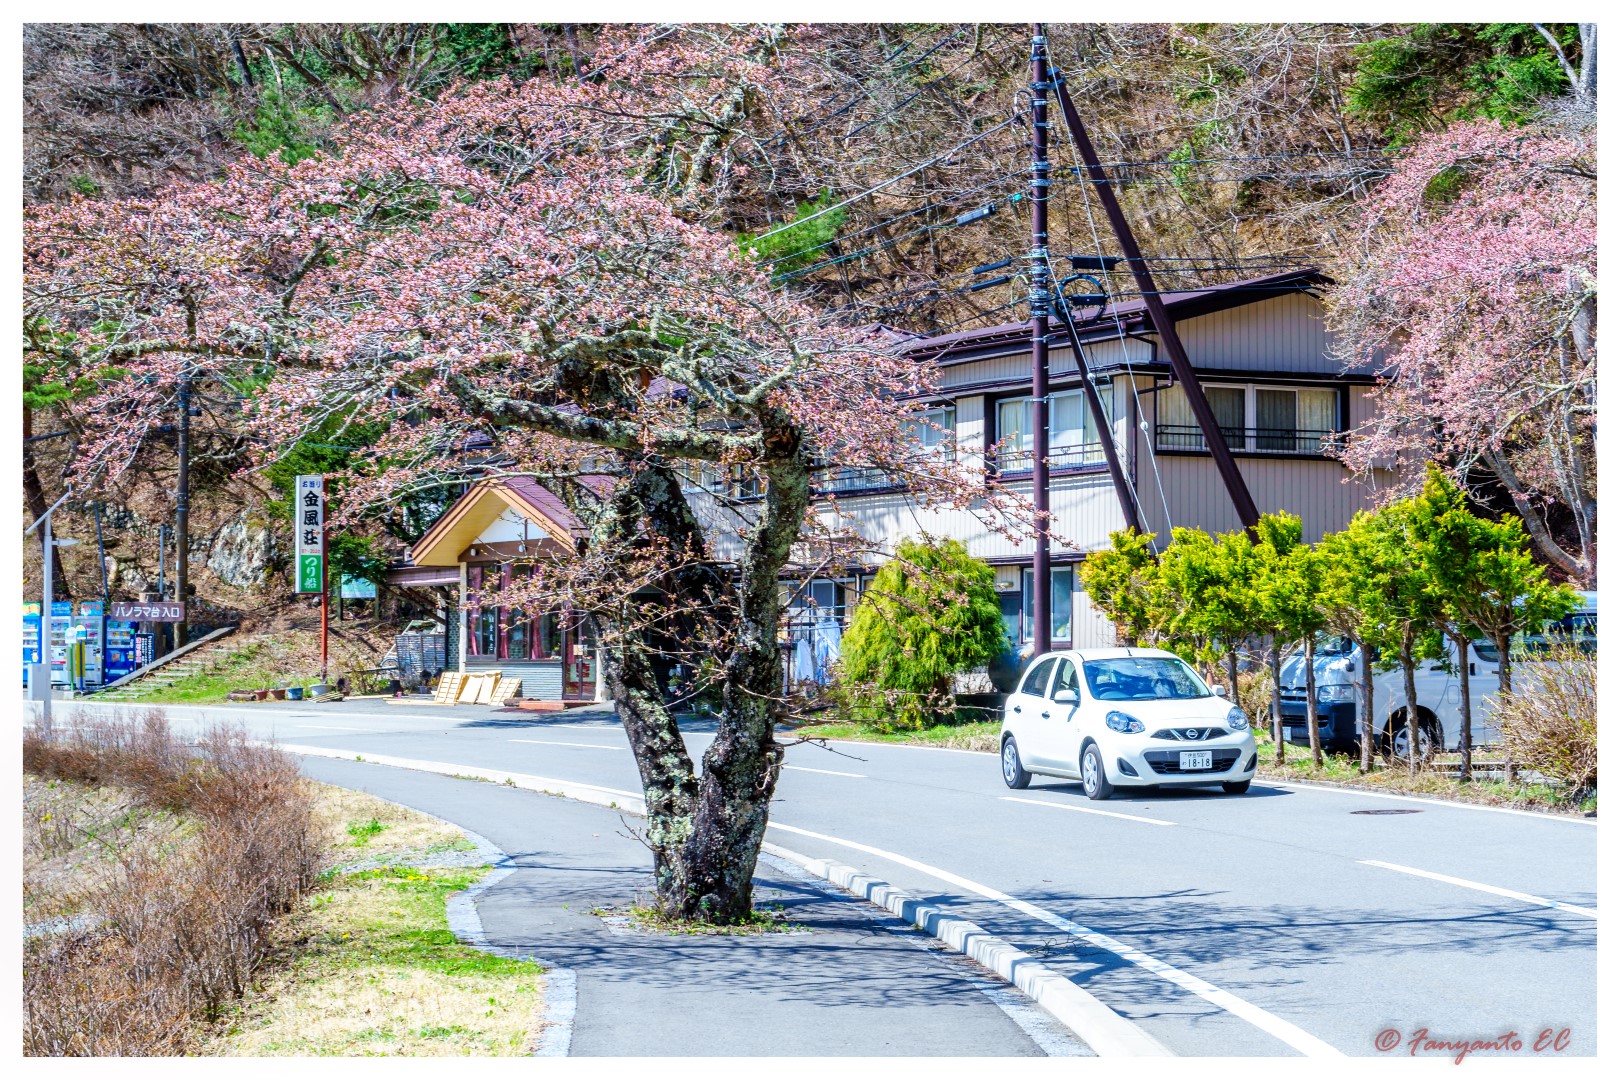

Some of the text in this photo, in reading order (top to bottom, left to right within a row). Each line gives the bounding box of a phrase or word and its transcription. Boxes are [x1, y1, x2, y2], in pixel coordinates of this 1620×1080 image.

[304, 491, 319, 545] 金風荘
[304, 557, 318, 589] つり船
[116, 607, 180, 618] パノラマ台 入口
[1189, 758, 1210, 767] 18-18
